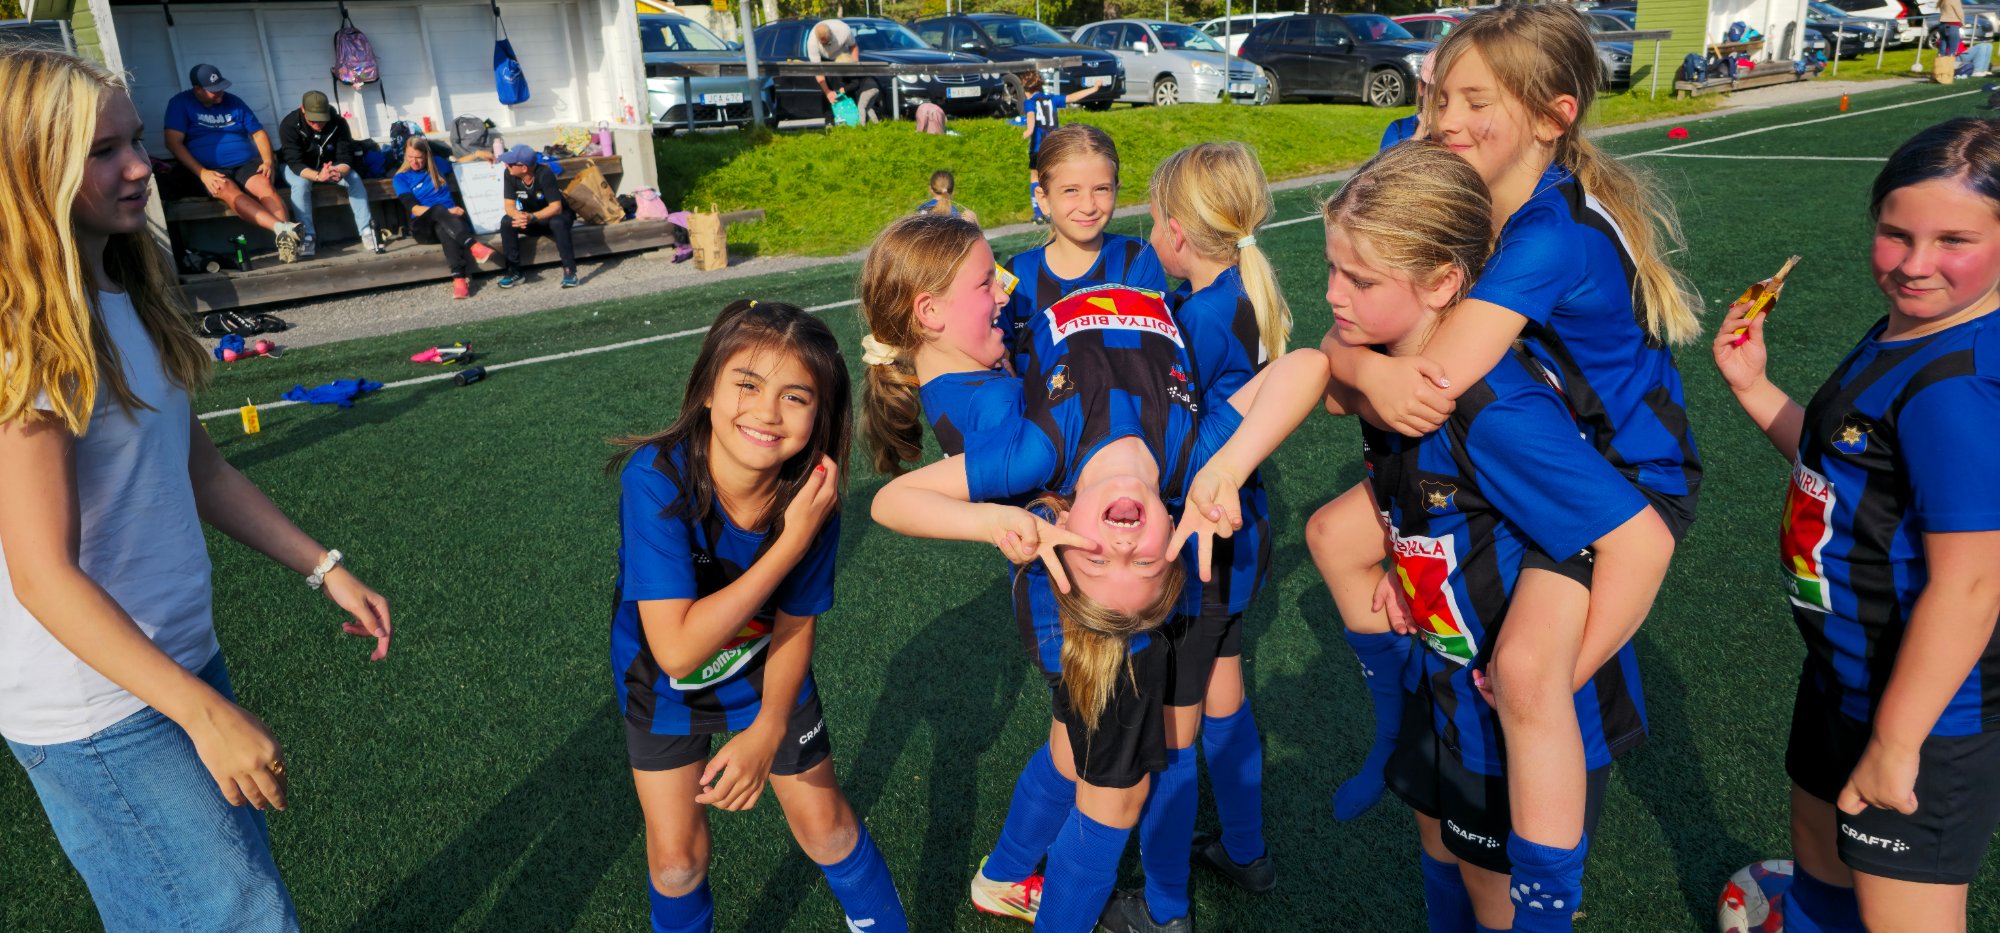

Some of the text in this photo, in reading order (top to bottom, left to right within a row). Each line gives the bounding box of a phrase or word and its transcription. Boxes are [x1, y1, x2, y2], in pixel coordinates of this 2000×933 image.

[1057, 316, 1178, 338] ADITYA BIRLA
[1447, 819, 1487, 844] CRAFT
[1841, 823, 1892, 848] CRAFT
